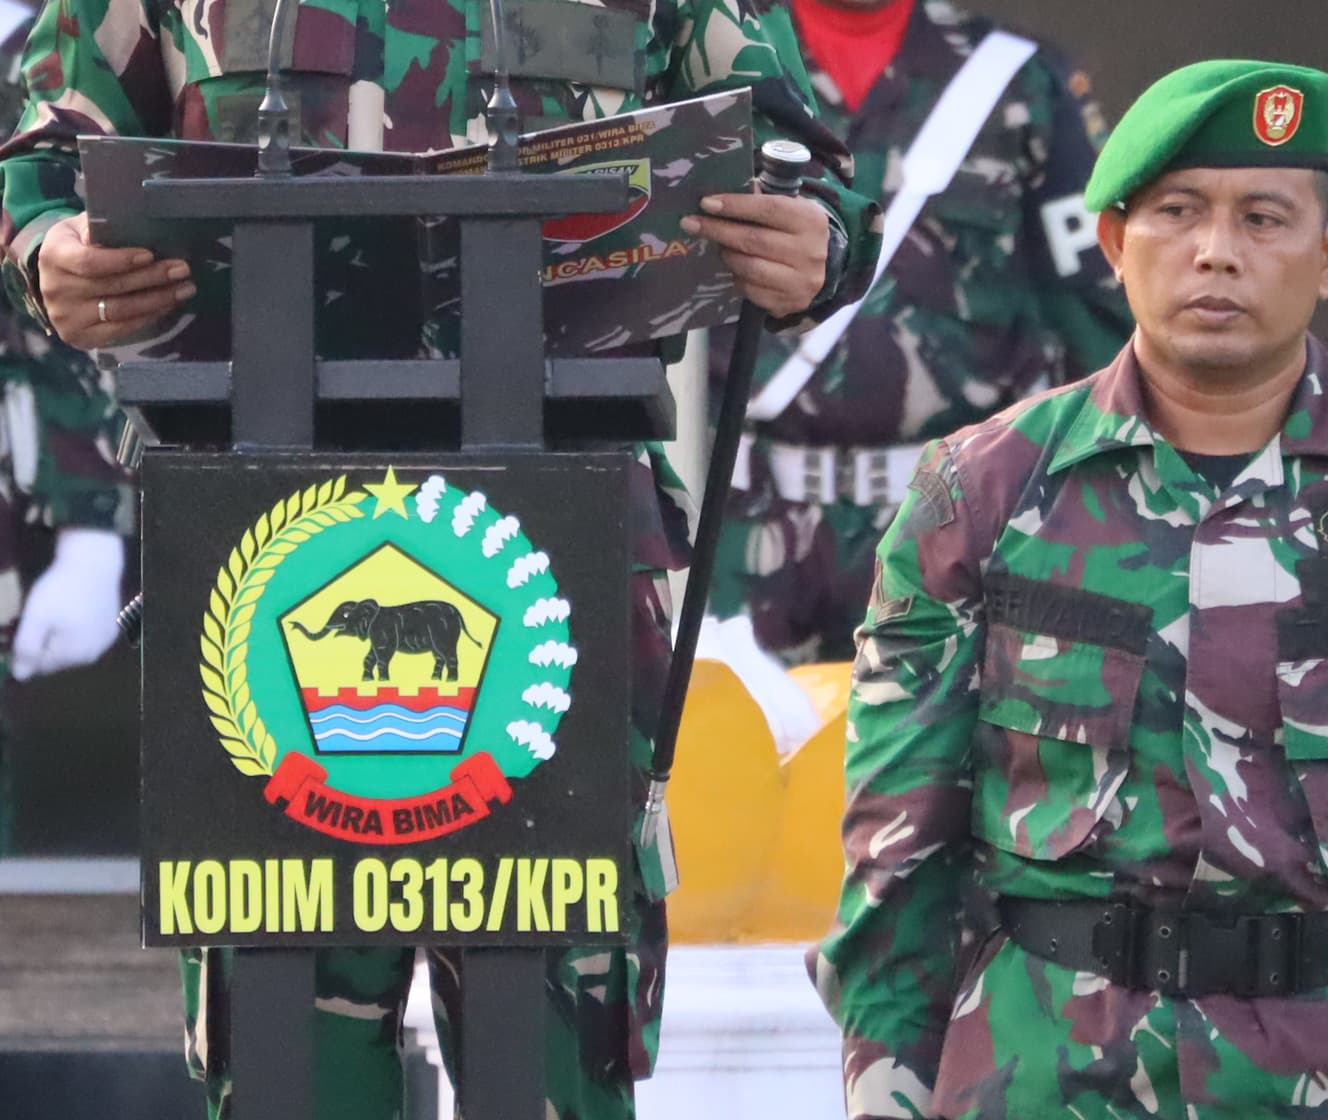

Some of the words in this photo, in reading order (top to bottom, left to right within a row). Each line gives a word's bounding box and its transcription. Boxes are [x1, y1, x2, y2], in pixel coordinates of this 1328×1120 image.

[304, 791, 384, 836] WIRA
[392, 793, 474, 836] BIMA
[159, 858, 334, 935] KODIM
[352, 857, 620, 933] 0313/KPR
